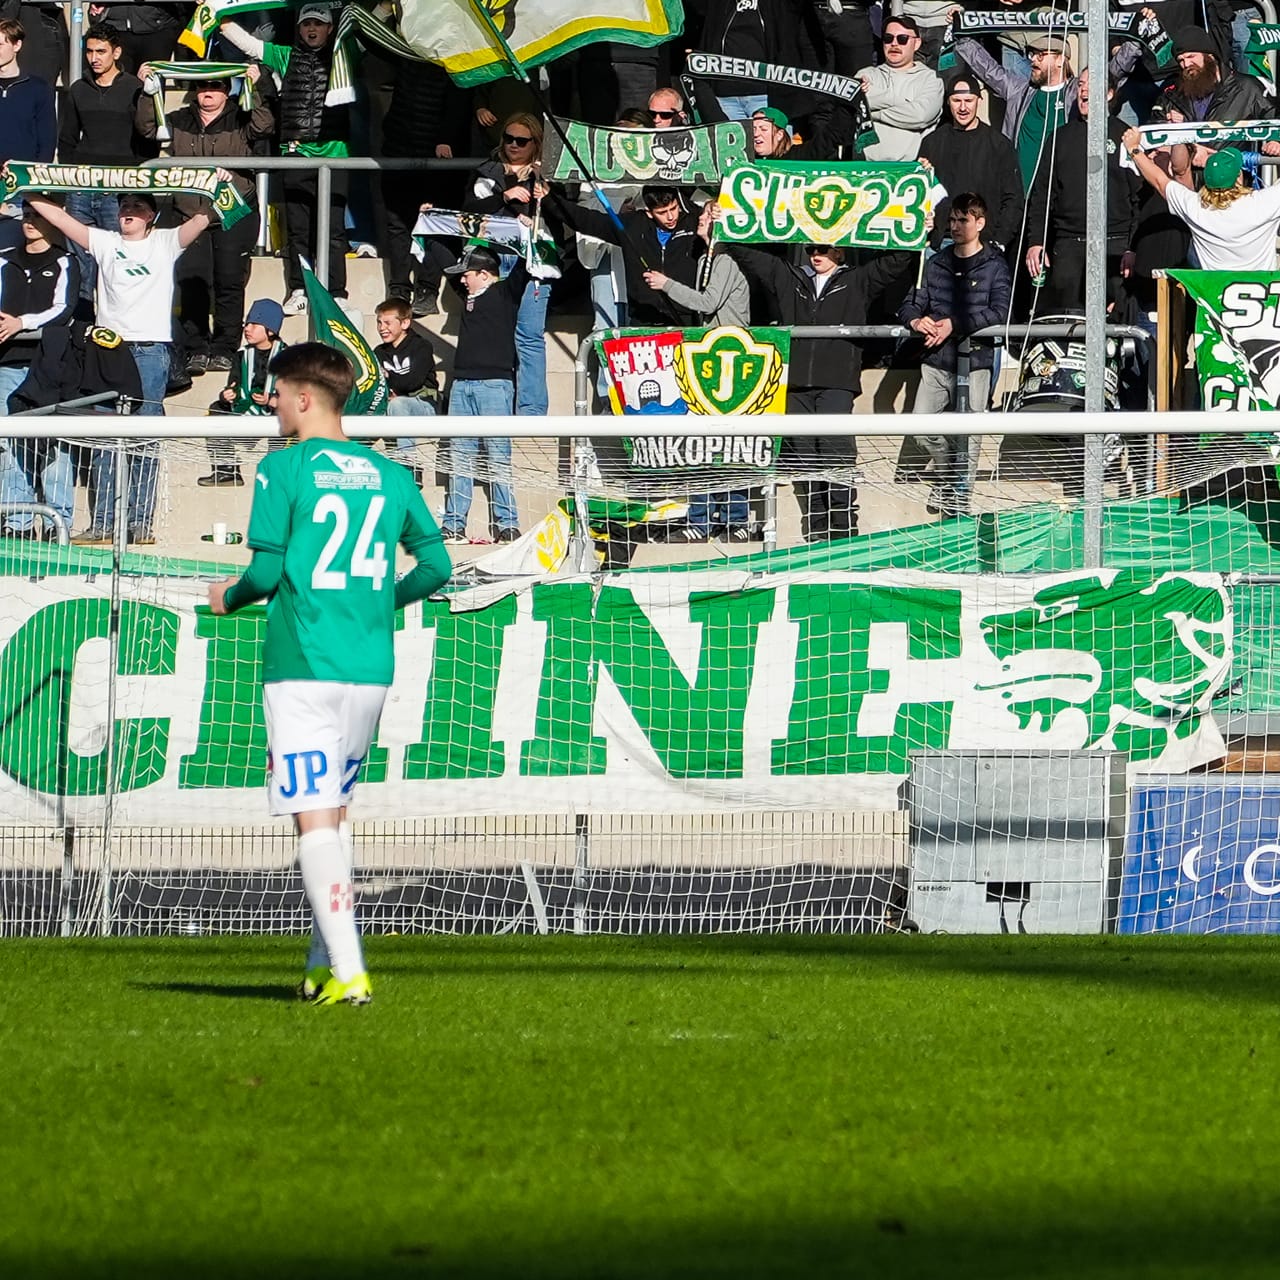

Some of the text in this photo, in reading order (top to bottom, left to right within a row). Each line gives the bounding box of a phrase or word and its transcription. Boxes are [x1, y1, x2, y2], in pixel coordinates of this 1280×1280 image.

[692, 54, 862, 103] GREEN MACHINE
[27, 165, 217, 191] JÖNKÖPINGS SÖDRA
[853, 173, 930, 247] 23
[311, 494, 388, 591] 24
[281, 750, 328, 798] JP
